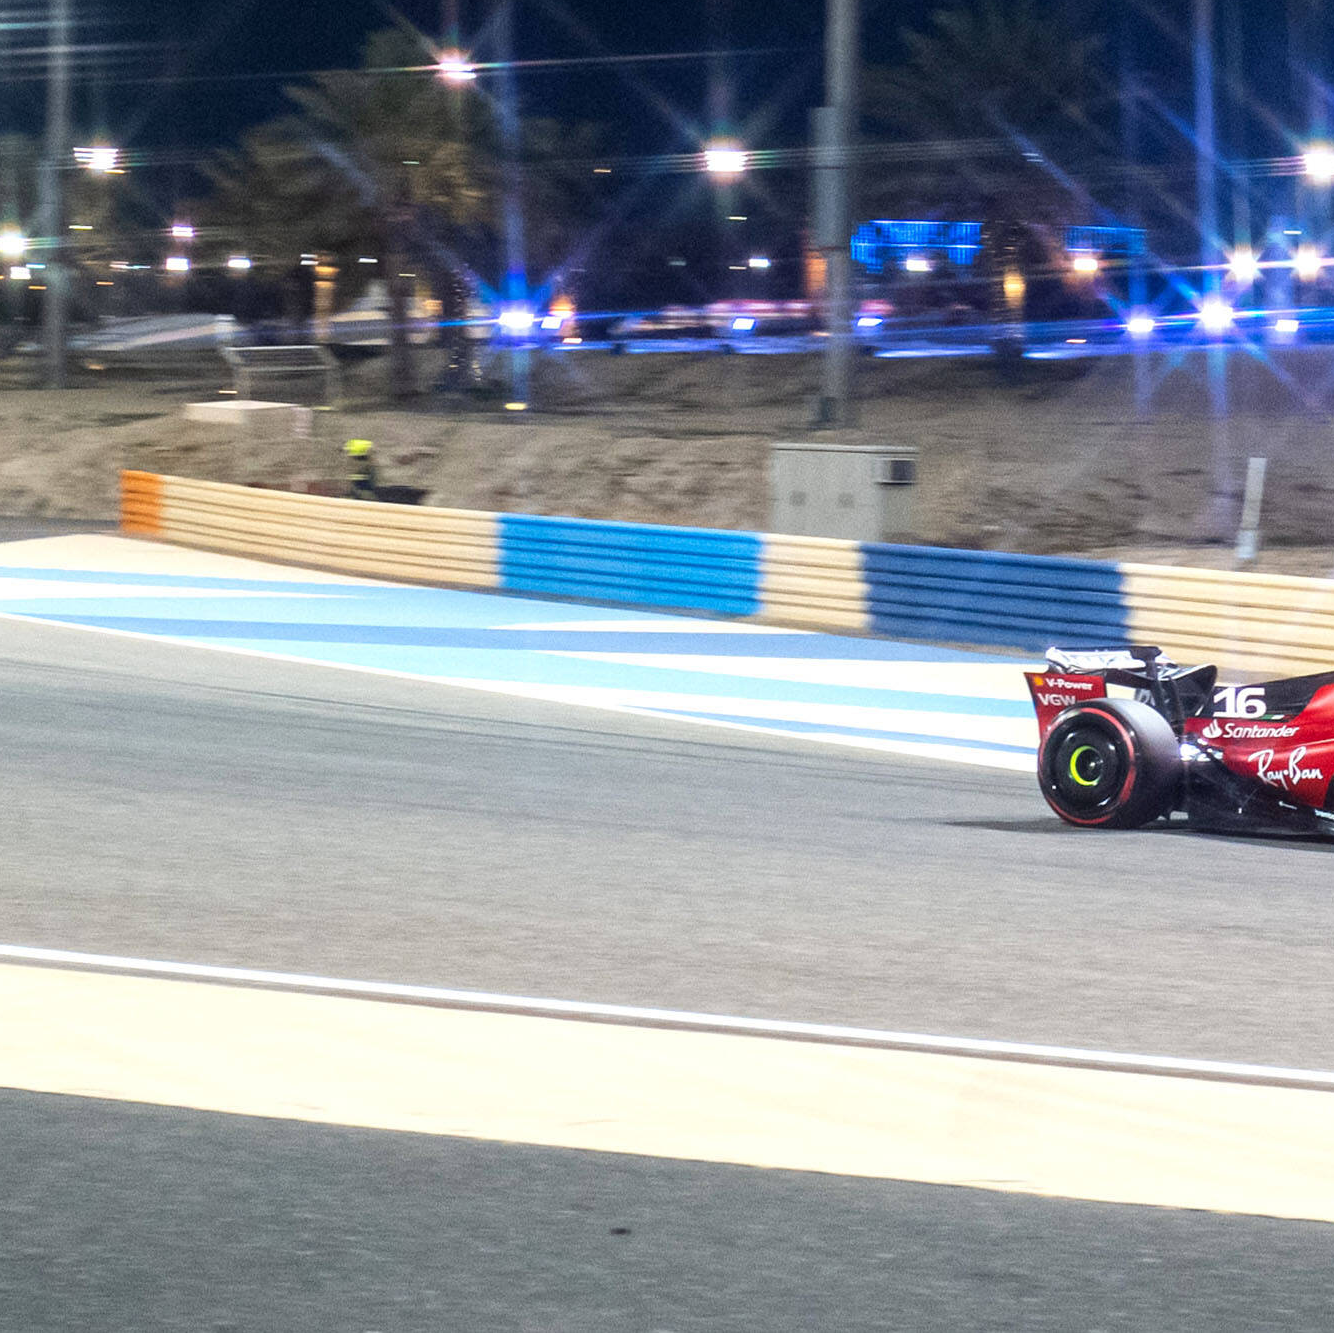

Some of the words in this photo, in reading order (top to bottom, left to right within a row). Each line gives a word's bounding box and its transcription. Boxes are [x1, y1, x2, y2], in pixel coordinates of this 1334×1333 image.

[1045, 677, 1093, 691] V-Power
[1037, 693, 1076, 706] VGW
[1213, 687, 1267, 719] 16
[1223, 723, 1299, 738] Santander
